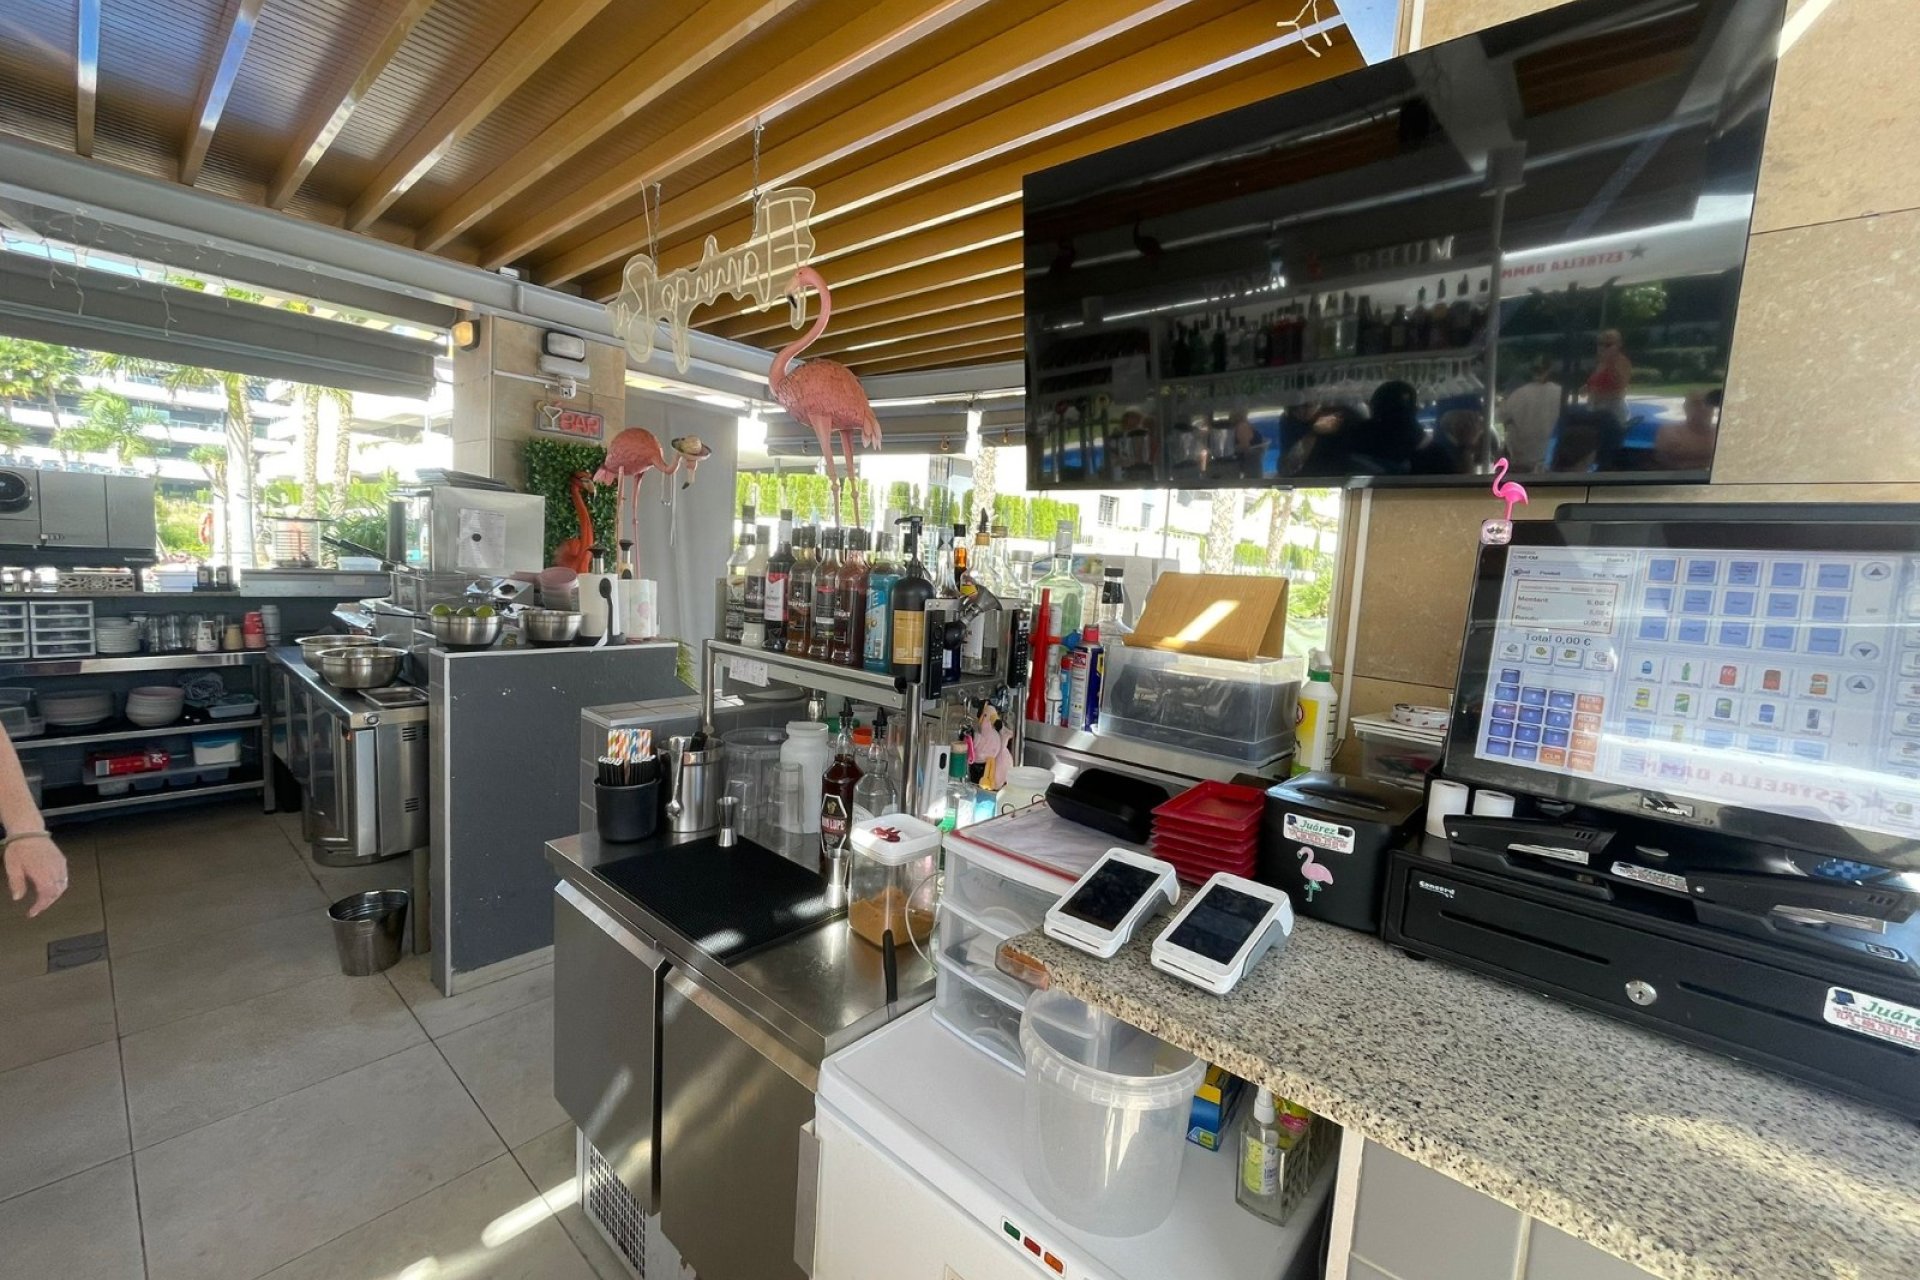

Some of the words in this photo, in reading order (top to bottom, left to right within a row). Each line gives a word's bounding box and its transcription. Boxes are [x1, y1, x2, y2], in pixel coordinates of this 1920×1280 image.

[559, 412, 600, 436] BAR
[1524, 633, 1552, 643] Total
[1300, 820, 1337, 835] Juárez
